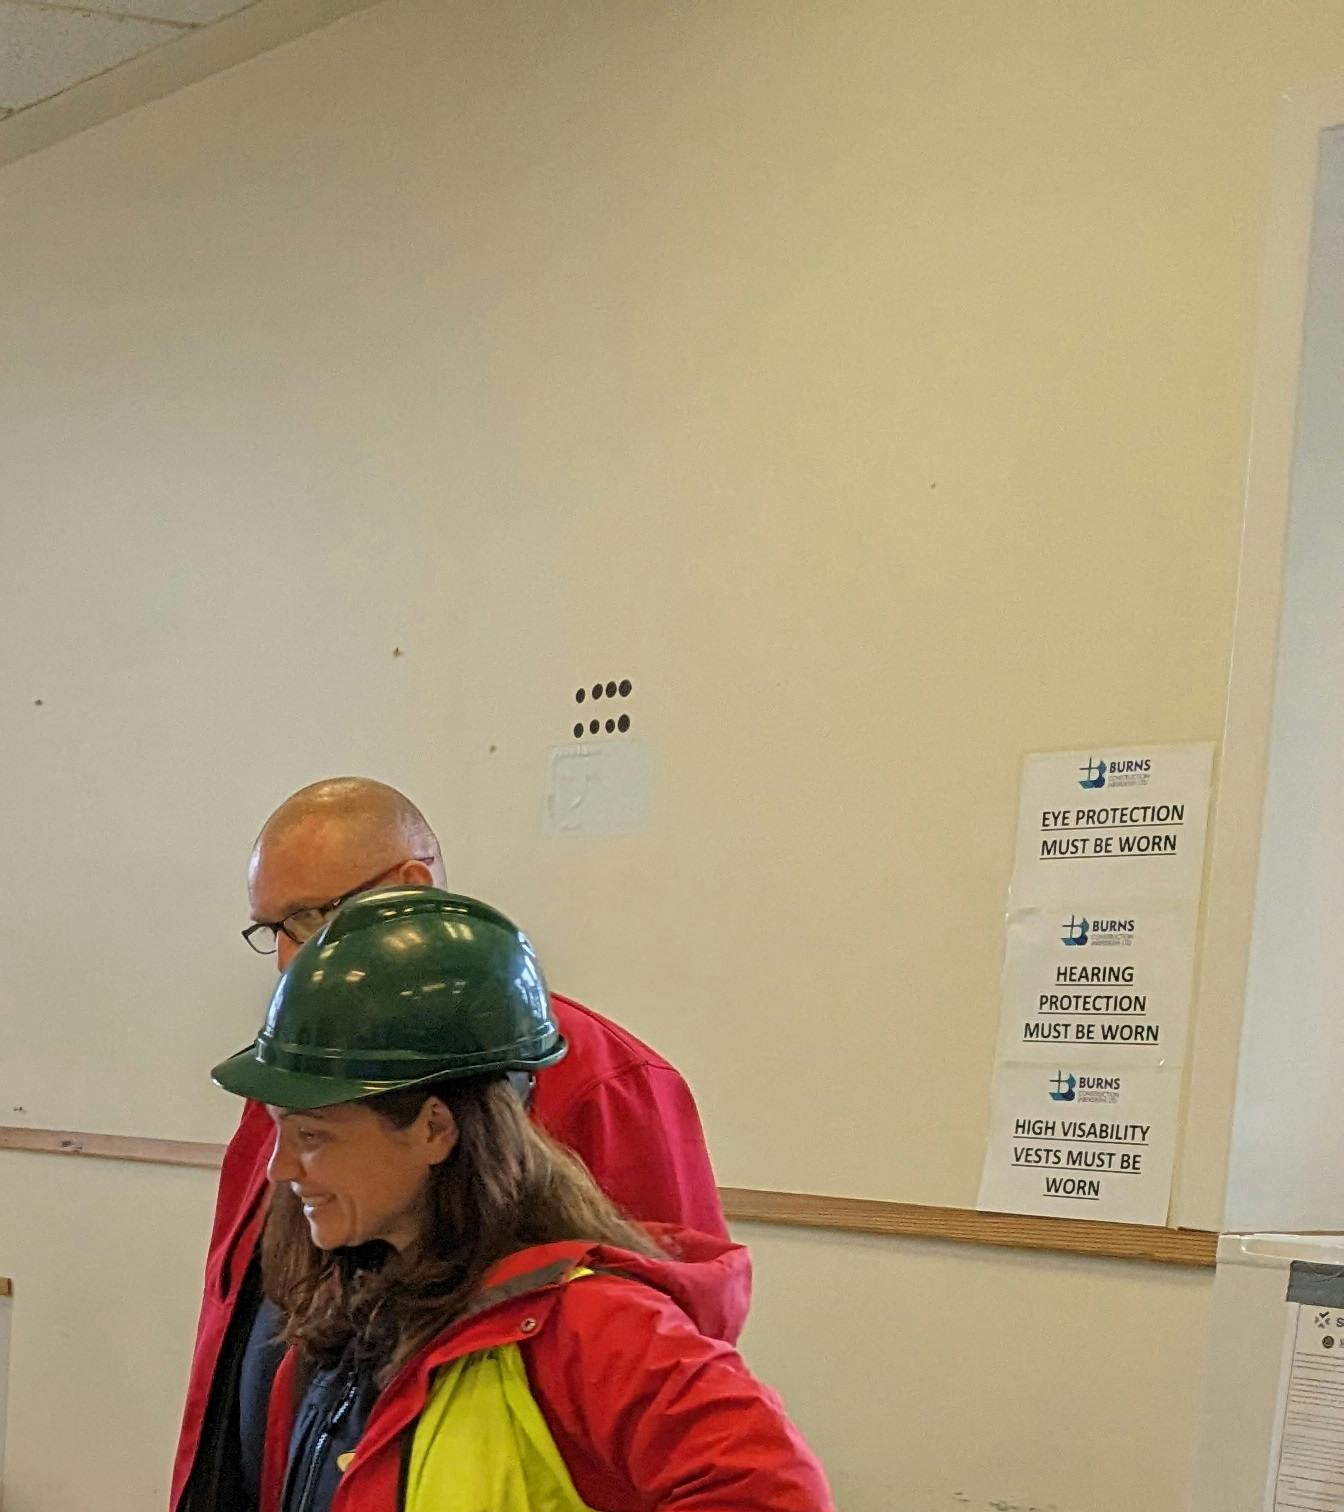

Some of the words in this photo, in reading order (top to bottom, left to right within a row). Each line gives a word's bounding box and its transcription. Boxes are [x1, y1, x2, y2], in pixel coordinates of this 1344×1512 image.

[1109, 759, 1151, 773] BURNS
[1042, 811, 1070, 827] EYE
[1076, 805, 1185, 826] PROTECTION
[1041, 838, 1089, 856] MUST
[1094, 837, 1114, 854] BE
[1119, 835, 1177, 853] WORN
[1092, 920, 1135, 932] BURNS
[1056, 966, 1135, 983] HEARING
[1039, 994, 1147, 1012] PROTECTION
[1023, 1023, 1072, 1039] MUST
[1075, 1024, 1096, 1040] BE
[1101, 1024, 1160, 1042] WORN
[1078, 1077, 1120, 1090] BURNS
[1014, 1118, 1056, 1136] HIGH
[1061, 1121, 1151, 1142] VISABILITY
[1013, 1147, 1062, 1165] VESTS
[1066, 1151, 1116, 1169] MUST
[1120, 1154, 1142, 1171] BE
[1045, 1177, 1100, 1197] WORN
